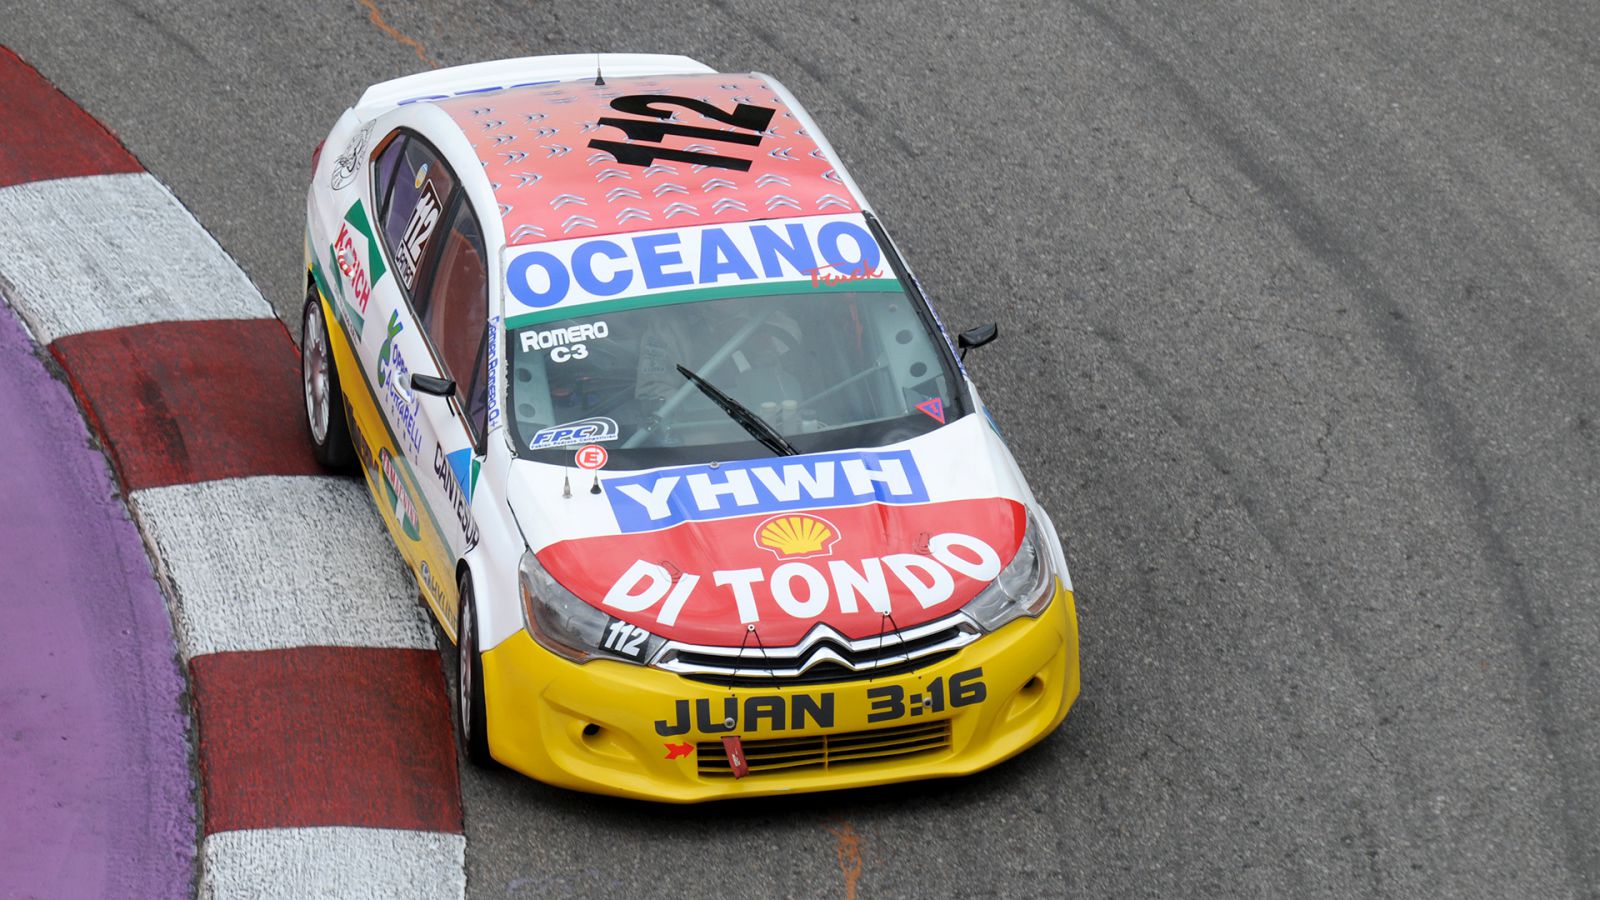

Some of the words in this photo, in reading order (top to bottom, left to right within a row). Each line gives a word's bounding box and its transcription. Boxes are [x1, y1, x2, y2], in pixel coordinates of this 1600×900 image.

[588, 95, 776, 172] 112
[404, 192, 439, 262] 112
[506, 221, 880, 308] OCEANO
[801, 260, 883, 288] Truck
[520, 321, 608, 352] ROMERO
[550, 344, 588, 363] C3
[533, 426, 597, 445] FPC
[583, 451, 599, 463] E
[616, 459, 912, 520] YHWH
[602, 560, 700, 626] DI
[714, 532, 1001, 624] TONDO
[604, 620, 650, 656] 112
[654, 693, 835, 737] JUAN
[867, 667, 987, 723] 3:16
